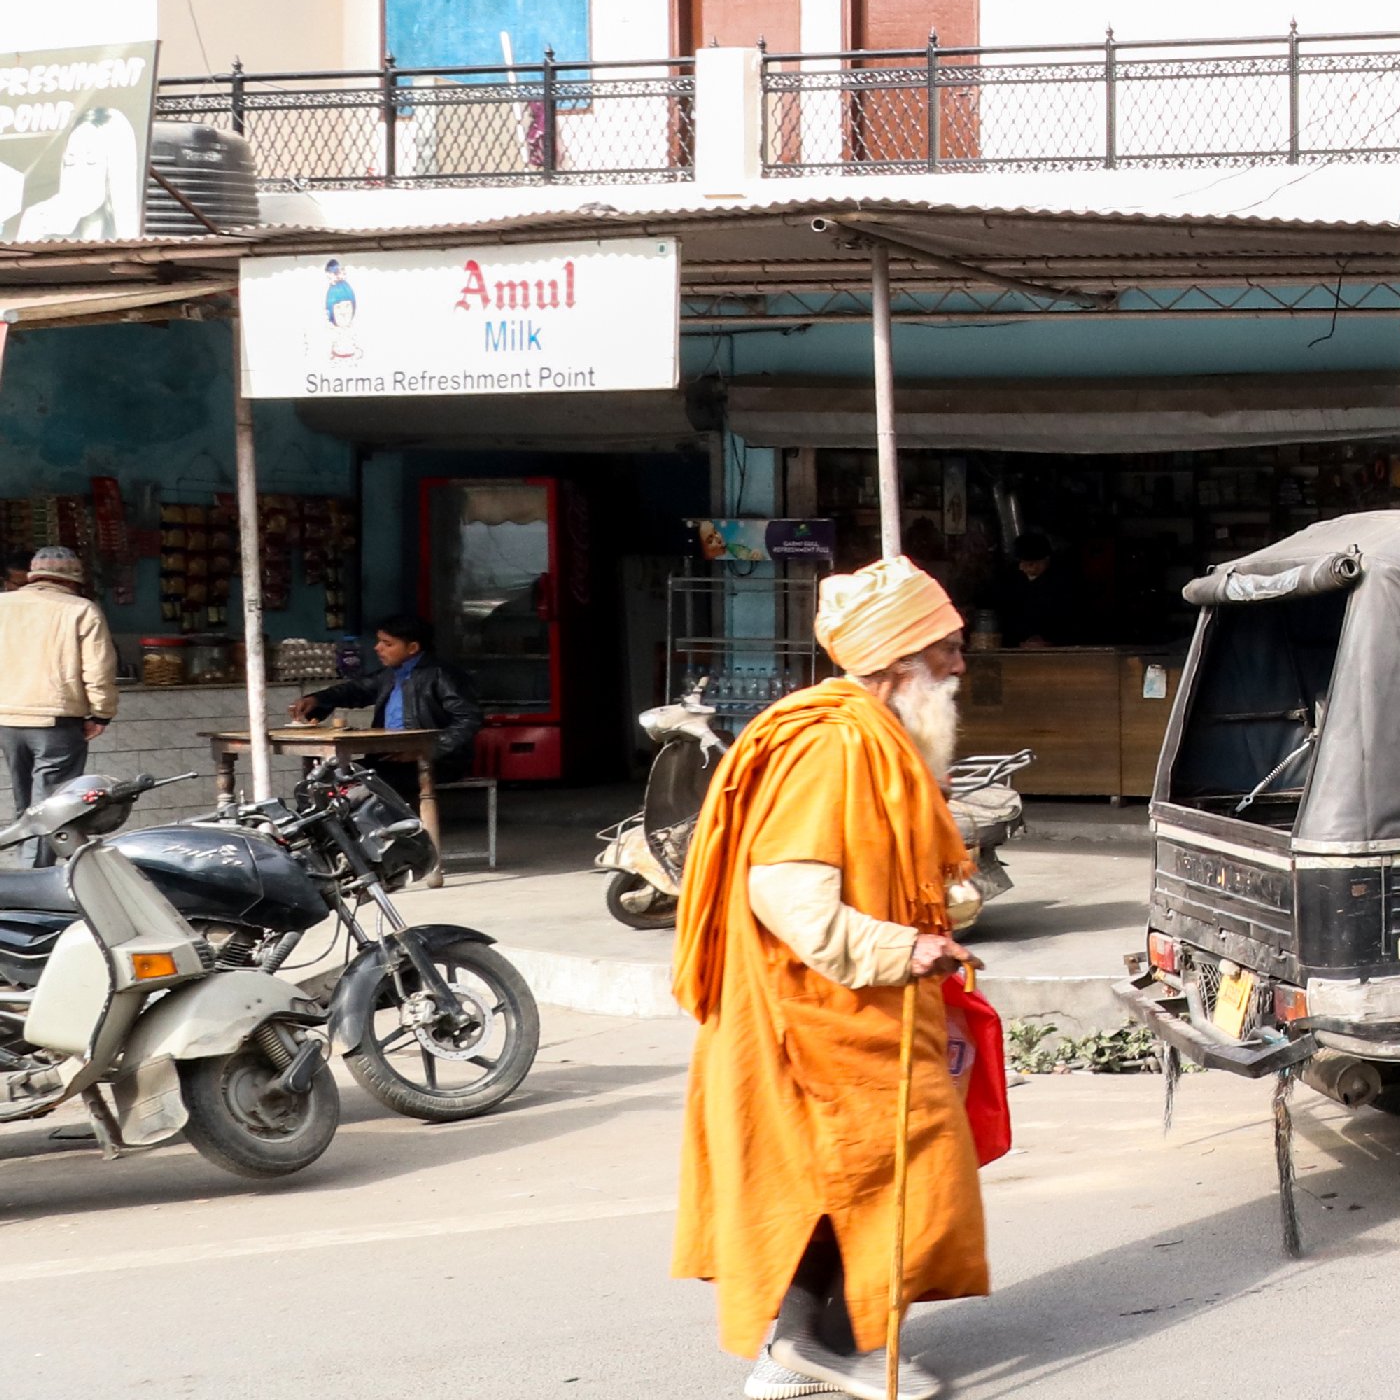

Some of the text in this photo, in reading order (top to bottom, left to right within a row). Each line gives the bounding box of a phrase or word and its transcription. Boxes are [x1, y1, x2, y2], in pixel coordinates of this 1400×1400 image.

[454, 259, 576, 312] Amul
[484, 320, 542, 352] Milk
[306, 366, 596, 393] Sharma Refreshment Point
